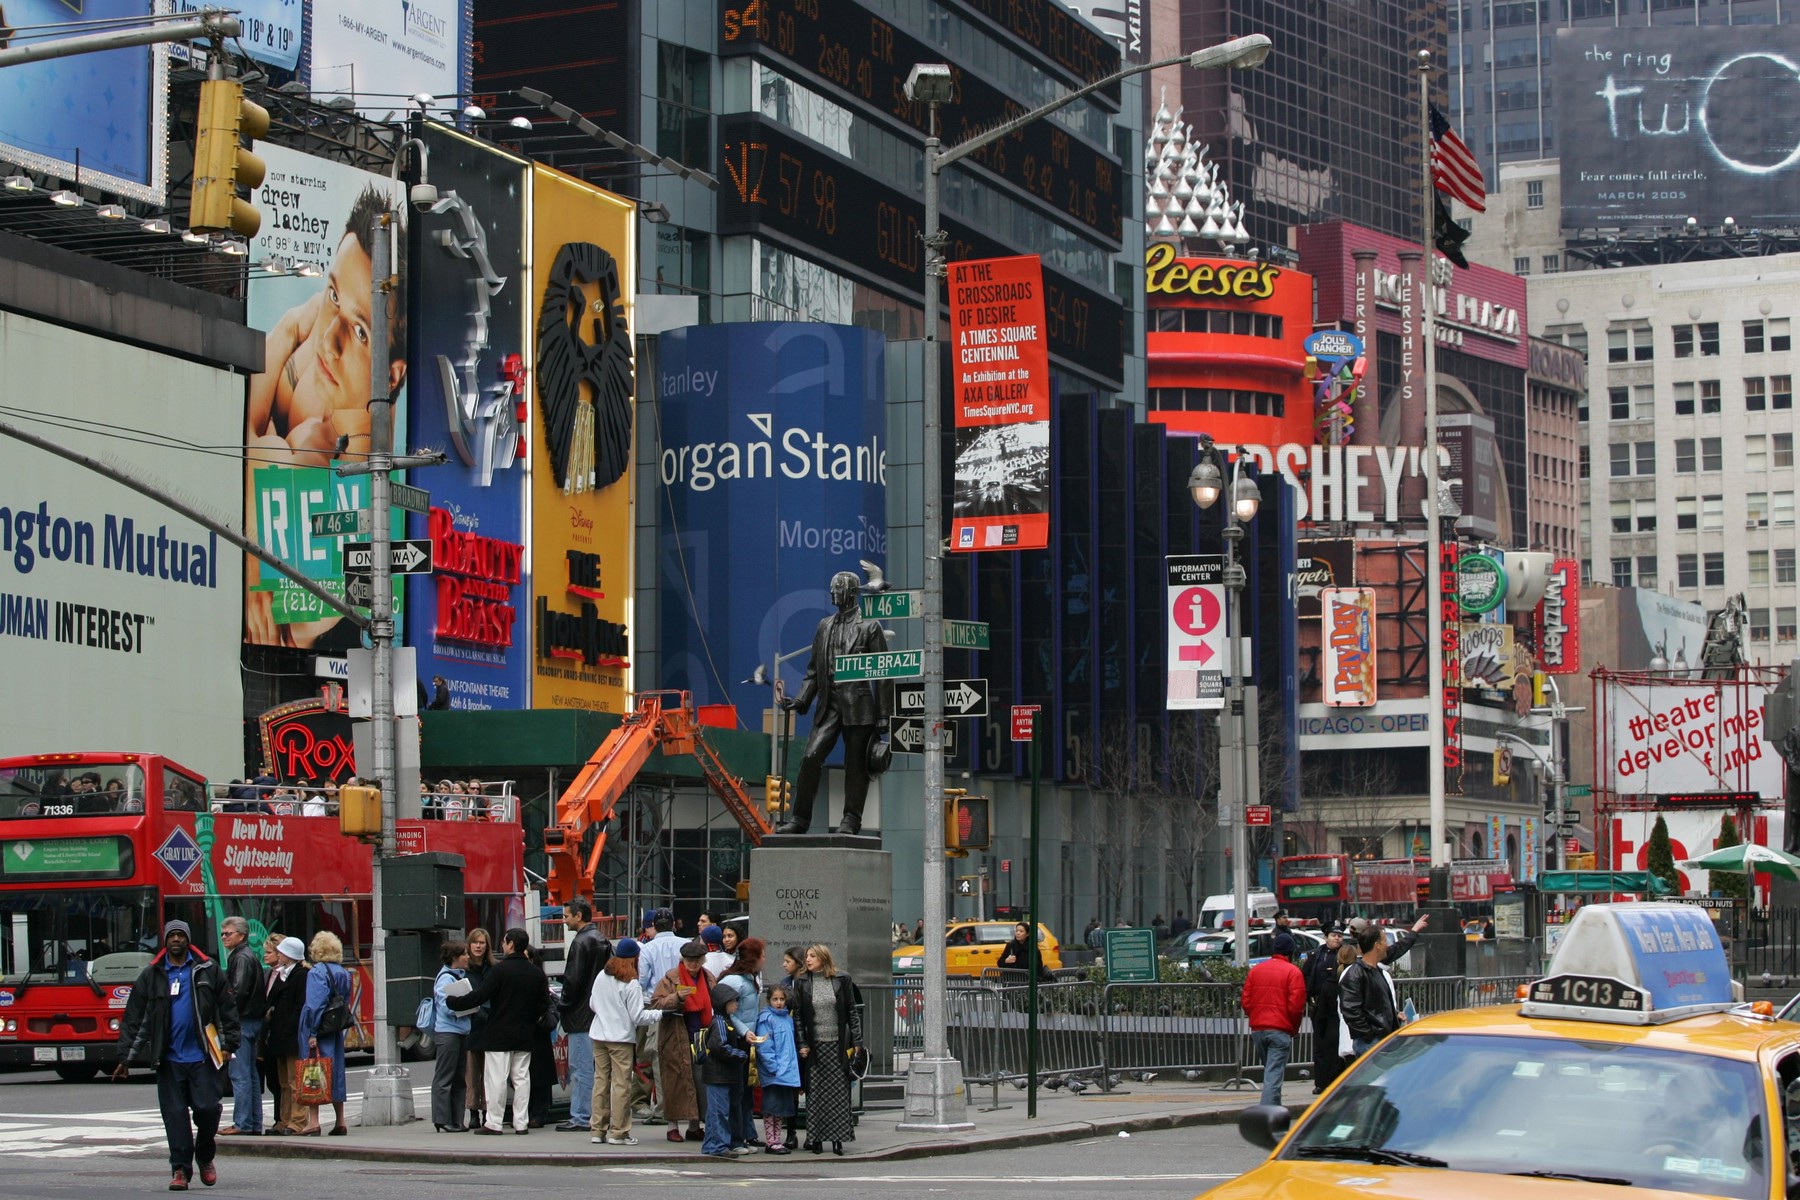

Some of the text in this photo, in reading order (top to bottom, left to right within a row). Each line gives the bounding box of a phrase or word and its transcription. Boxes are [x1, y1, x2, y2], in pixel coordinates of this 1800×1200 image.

[338, 14, 388, 45] 1-866-MY-ARGENT
[408, 2, 447, 38] ARGENT
[248, 17, 294, 52] 18th & 19th
[392, 40, 447, 71] www.argentloans.com
[1585, 44, 1672, 74] the ring
[271, 171, 327, 191] now starring
[1580, 171, 1708, 182] Fear comes full circle.
[261, 184, 301, 209] drew
[1598, 191, 1687, 200] MARCH 2005
[272, 208, 330, 240] lachey
[260, 235, 273, 248] of
[293, 241, 300, 252] &
[303, 240, 332, 256] MTV's
[877, 200, 919, 273] GILD
[956, 263, 993, 284] AT THE
[1147, 242, 1280, 298] Reese's
[957, 282, 1032, 305] CROSSROADS
[959, 305, 1017, 327] OF DESIRE
[960, 325, 1037, 346] A TIMES SQUARE
[1320, 334, 1345, 346] JOLLY
[1402, 272, 1413, 399] HERSHEYS
[961, 345, 1020, 364] CENTENNIAL
[1313, 343, 1352, 354] RANCHER
[962, 368, 1029, 383] An Exhibition at the
[963, 383, 1030, 403] AXA GALLERY
[963, 404, 1034, 418] TimesSquareNYC.org
[659, 427, 886, 491] organ Stanle
[392, 483, 428, 512] BROADWAY
[261, 484, 361, 563] REN
[315, 512, 355, 534] W 46 ST
[569, 506, 594, 536] Disney
[429, 506, 525, 585] BEAUTY
[780, 520, 868, 555] Morgan
[103, 513, 218, 589] Mutual
[355, 550, 418, 565] ON WAY
[566, 550, 602, 589] THE
[1170, 564, 1222, 573] INFORMATION
[1181, 573, 1211, 581] CENTER
[352, 583, 367, 597] ONE
[436, 574, 517, 648] BEAST
[864, 595, 906, 616] W 46 ST
[951, 625, 987, 645] TIMES SQ
[433, 644, 507, 665] BROADWAY'S CLASSIC MUSICAL
[835, 652, 920, 672] LITTLE BRAZIL
[537, 665, 608, 686] BROADWAY'S AWARD-WINNING BEST
[864, 668, 889, 677] STREET
[488, 686, 509, 699] THEATRE
[551, 694, 610, 711] NEW AMSTERDAM THEATRE
[908, 691, 973, 706] ON WAY
[450, 697, 462, 710] 46th
[463, 699, 468, 710] &
[1013, 708, 1019, 716] NO
[1628, 693, 1716, 742] theatre
[901, 730, 920, 743] ONE
[1617, 705, 1765, 777] developme
[1704, 734, 1763, 776] fund
[43, 804, 74, 816] 71336
[231, 818, 284, 841] New York
[396, 831, 422, 839] TANDING
[163, 847, 195, 861] GRAY LINE
[223, 845, 294, 874] Sightseeing
[775, 888, 820, 900] GEORGE
[1715, 900, 1733, 908] NUTS
[778, 909, 818, 920] COHAN
[793, 900, 804, 910] M
[1633, 925, 1659, 954] New
[1673, 923, 1698, 951] New
[1534, 991, 1554, 1001] DUTY
[1561, 979, 1613, 1005] 1C13
[1618, 999, 1638, 1008] DUTY
